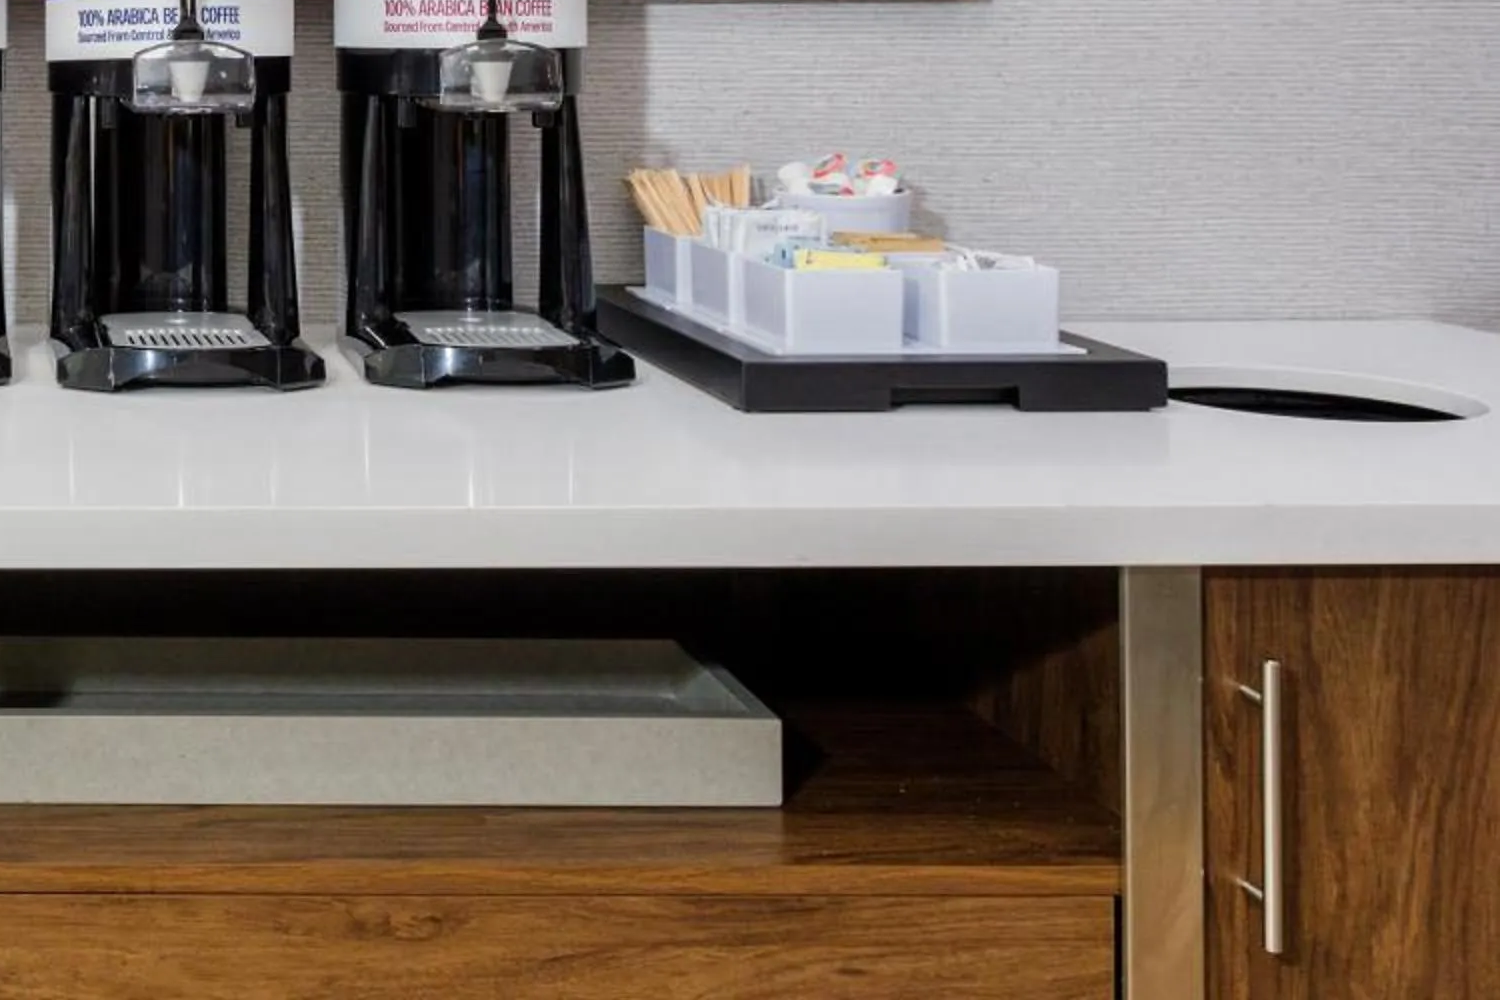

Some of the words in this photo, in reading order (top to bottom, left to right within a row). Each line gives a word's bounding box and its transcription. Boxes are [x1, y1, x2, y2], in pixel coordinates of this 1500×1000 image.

[384, 0, 415, 17] 100%
[418, 0, 475, 17] ARABICA
[479, 0, 513, 17] BAN
[515, 0, 553, 17] COFFEE
[78, 9, 104, 27] 100%
[107, 8, 160, 25] ARABICA
[201, 5, 240, 24] COFFEE
[520, 21, 553, 33] America
[206, 29, 241, 41] America
